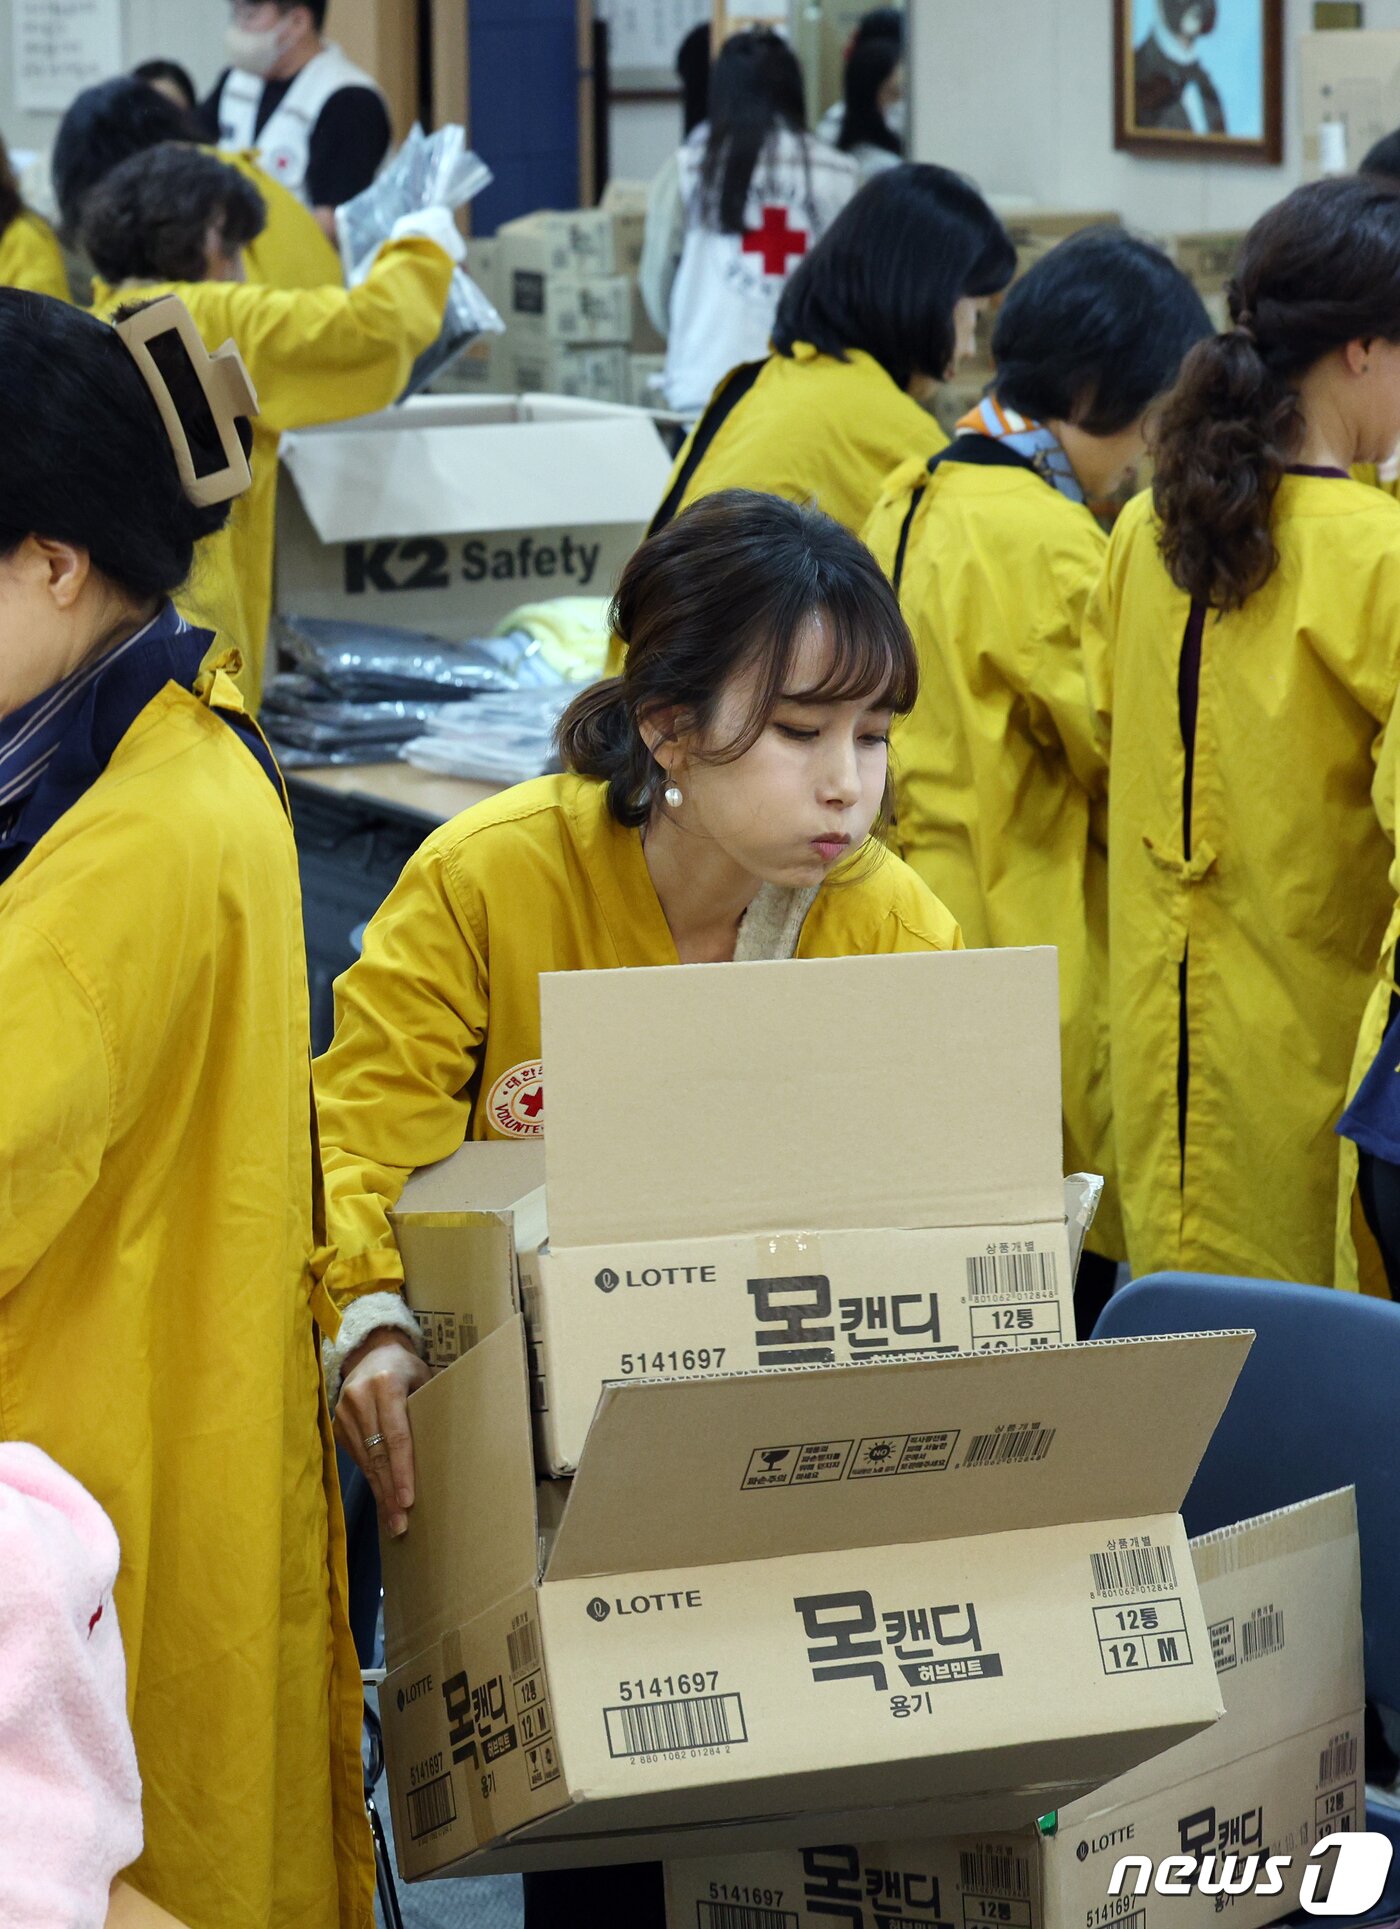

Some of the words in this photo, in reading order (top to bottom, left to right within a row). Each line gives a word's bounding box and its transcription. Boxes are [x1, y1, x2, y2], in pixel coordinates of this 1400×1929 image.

[344, 537, 450, 594] K2
[461, 536, 599, 585] Safety
[495, 1103, 543, 1134] VOLUNTE
[626, 1265, 717, 1288] LOTTE
[991, 1308, 1034, 1330] 12통
[621, 1347, 727, 1375] 5141697
[873, 1448, 888, 1456] NO
[1106, 1535, 1152, 1550] 상품개별
[615, 1590, 702, 1615] LOTTE
[1115, 1607, 1159, 1631] 12통
[793, 1589, 982, 1691] 목캔디
[1109, 1642, 1139, 1669] 12
[1157, 1637, 1179, 1663] M
[917, 1659, 984, 1682] 허브민트
[405, 1674, 433, 1704] LOTTE
[619, 1670, 719, 1701] 5141697
[889, 1691, 932, 1718] 용기
[442, 1670, 508, 1770] 목캔디
[521, 1714, 534, 1740] 12
[410, 1751, 443, 1786] 5141697
[481, 1770, 497, 1799] 용기
[1090, 1823, 1135, 1854] LOTTE
[709, 1881, 784, 1908] 5141697
[798, 1843, 941, 1929] 목캔디
[1086, 1893, 1137, 1928] 5141697
